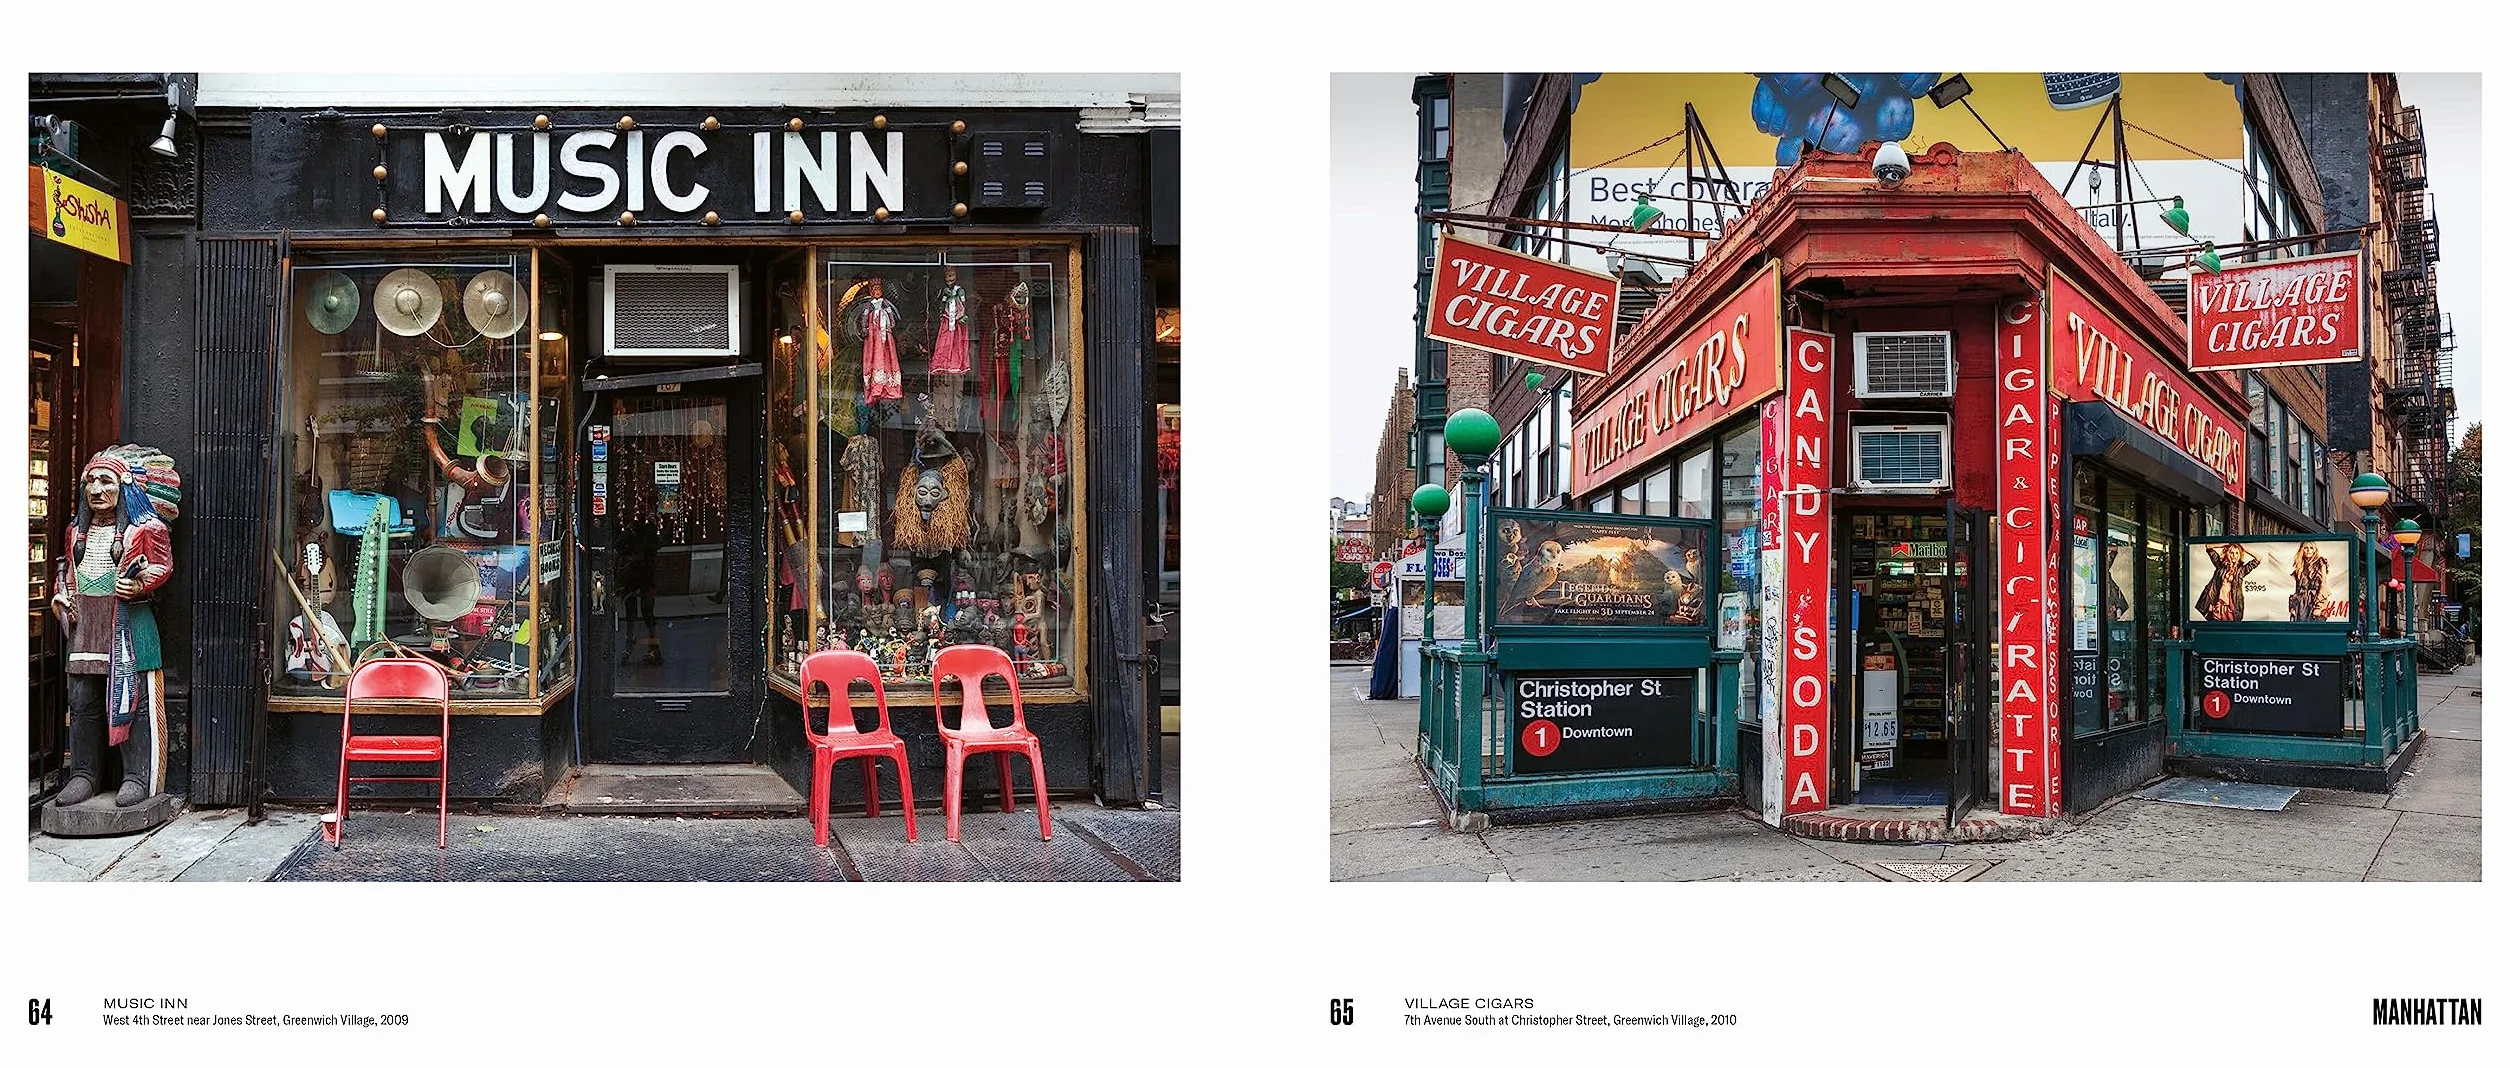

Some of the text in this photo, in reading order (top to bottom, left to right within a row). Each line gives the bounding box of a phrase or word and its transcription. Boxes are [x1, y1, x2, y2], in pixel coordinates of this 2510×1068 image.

[424, 130, 904, 213] MUSIC INN
[1590, 177, 1657, 202] Best
[1451, 258, 1608, 320] VILLAGE
[2200, 270, 2353, 315] VILLAGE
[1445, 294, 1603, 359] CIGARS
[2208, 312, 2341, 353] CIGARS
[2003, 301, 2035, 460] CIGAR
[1580, 312, 1750, 477] VILLAGE CIGARS
[2068, 311, 2240, 485] VILLAGE CIGARS
[1765, 400, 1779, 530] CIGAR
[2051, 403, 2060, 520] PIPES
[2013, 476, 2029, 490] &
[2074, 518, 2087, 531] AP
[1405, 563, 1426, 572] FL
[1790, 340, 1825, 805] CANDY SODA
[1558, 580, 1610, 600] LEGEND
[1575, 593, 1652, 608] GUARDIANS
[1600, 607, 1614, 616] 3D
[2322, 600, 2350, 618] H&M
[2204, 660, 2320, 677] Christopher St
[1519, 679, 1662, 700] Christopher St
[2203, 675, 2259, 690] Station
[1521, 701, 1592, 718] Station
[2211, 693, 2292, 712] 1 Downtown
[1534, 727, 1633, 748] 1 Downtown
[1865, 721, 1896, 738] $12.65
[1861, 752, 1889, 760] MAVERICK
